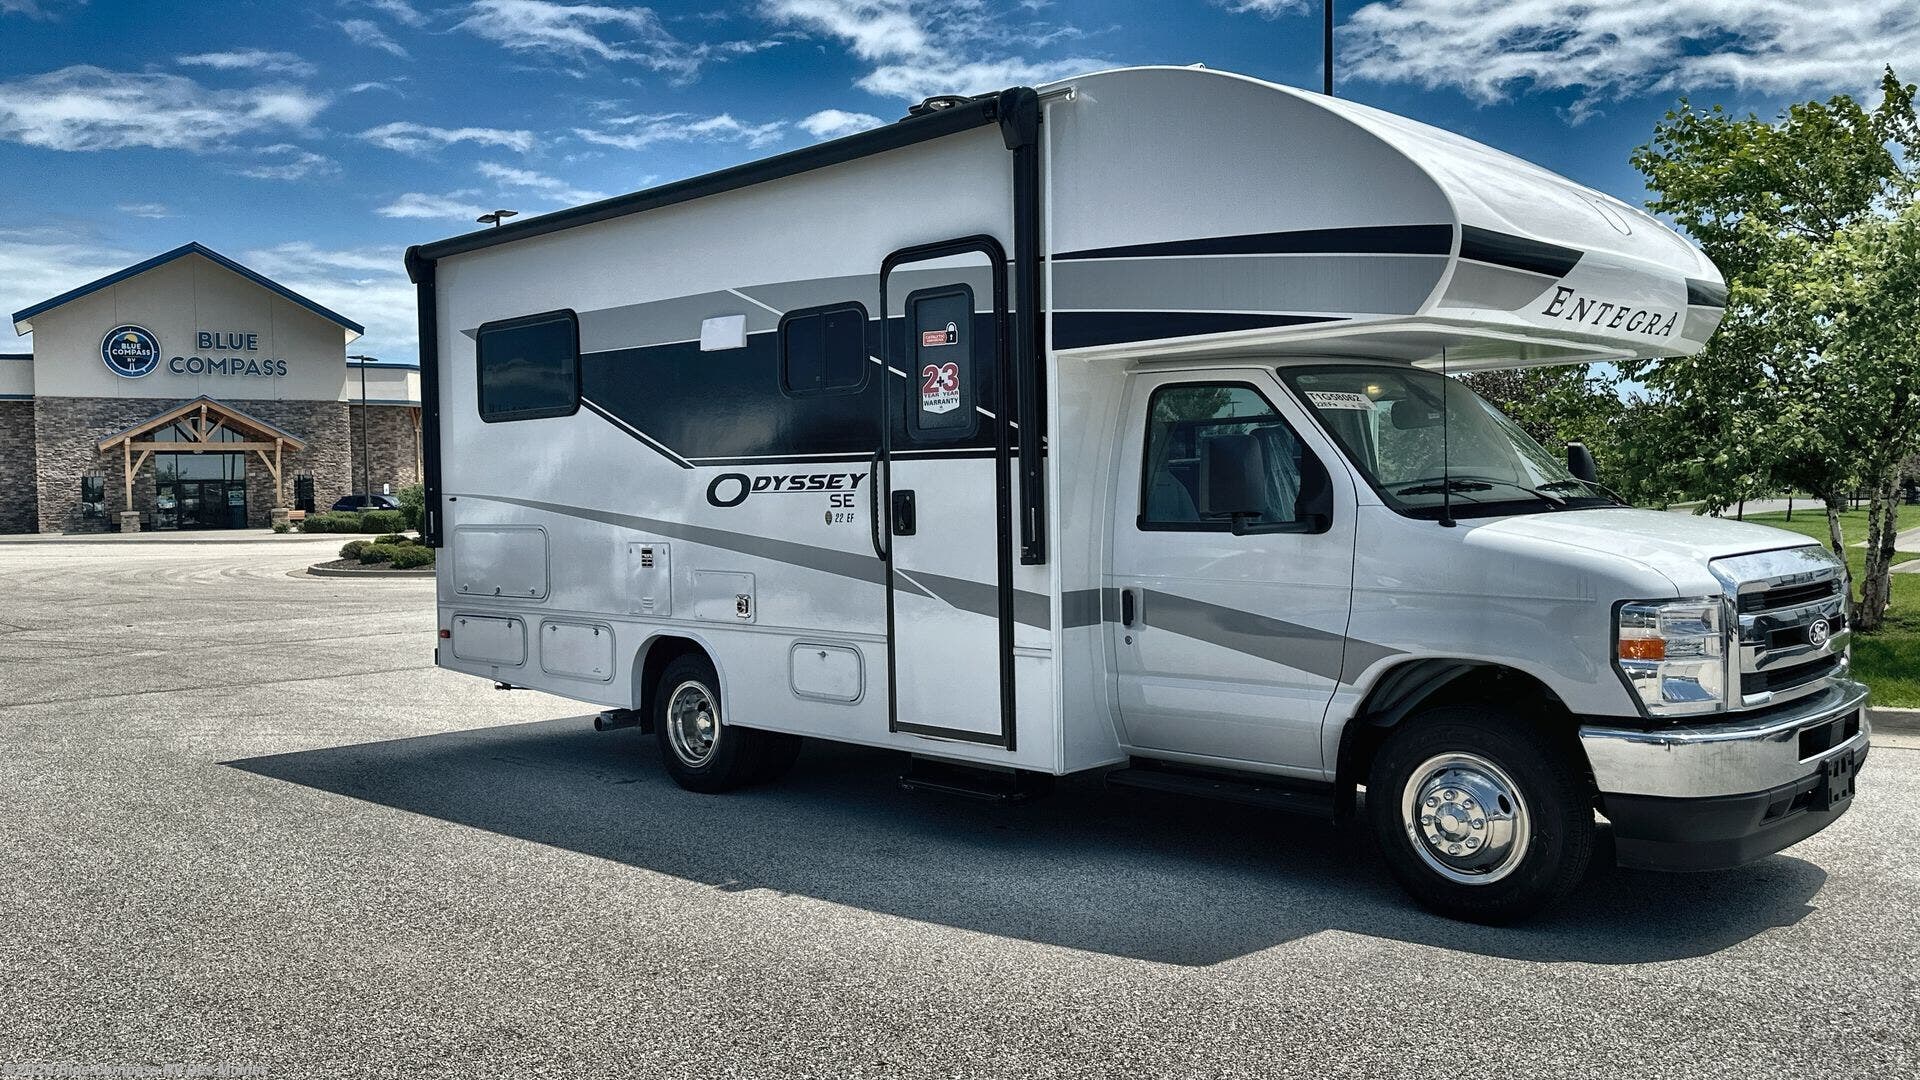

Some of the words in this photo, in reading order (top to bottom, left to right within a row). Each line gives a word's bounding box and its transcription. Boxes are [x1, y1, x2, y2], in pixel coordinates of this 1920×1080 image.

[1542, 286, 1678, 336] ENTEGRA
[198, 331, 258, 351] BLUE
[169, 356, 288, 376] COMPASS
[924, 397, 959, 406] WARRANTY
[706, 472, 868, 507] ODYSSEY
[830, 494, 855, 507] SE
[835, 513, 844, 523] 22
[847, 513, 854, 523] EF
